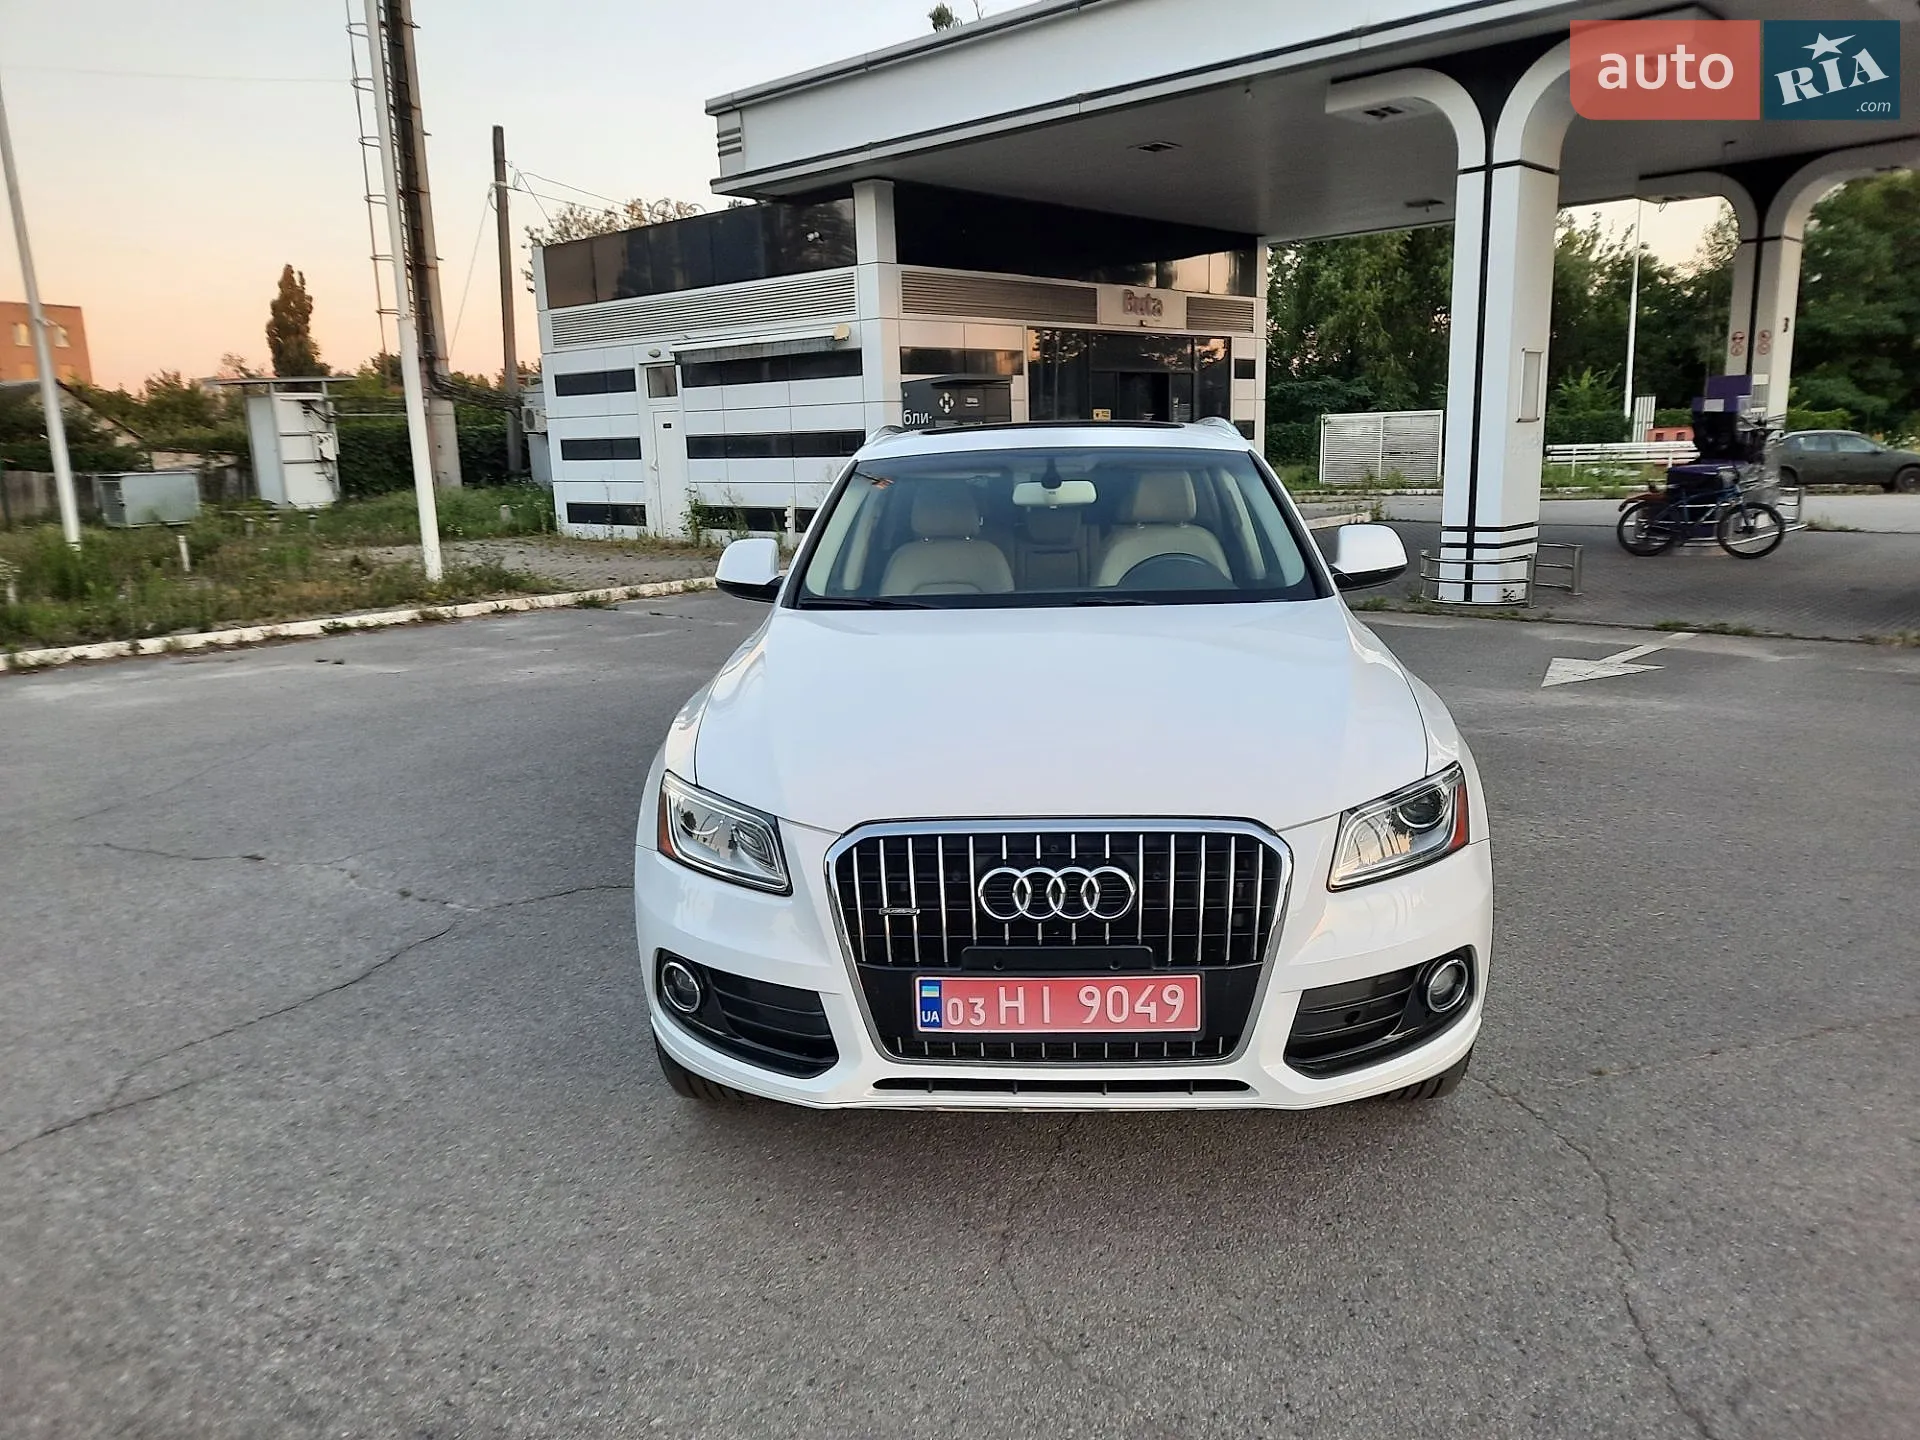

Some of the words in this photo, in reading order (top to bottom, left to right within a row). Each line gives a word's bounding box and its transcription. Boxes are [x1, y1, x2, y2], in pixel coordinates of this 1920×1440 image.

[921, 1010, 940, 1023] UA
[946, 997, 986, 1026] 03
[1078, 984, 1185, 1024] 9049
